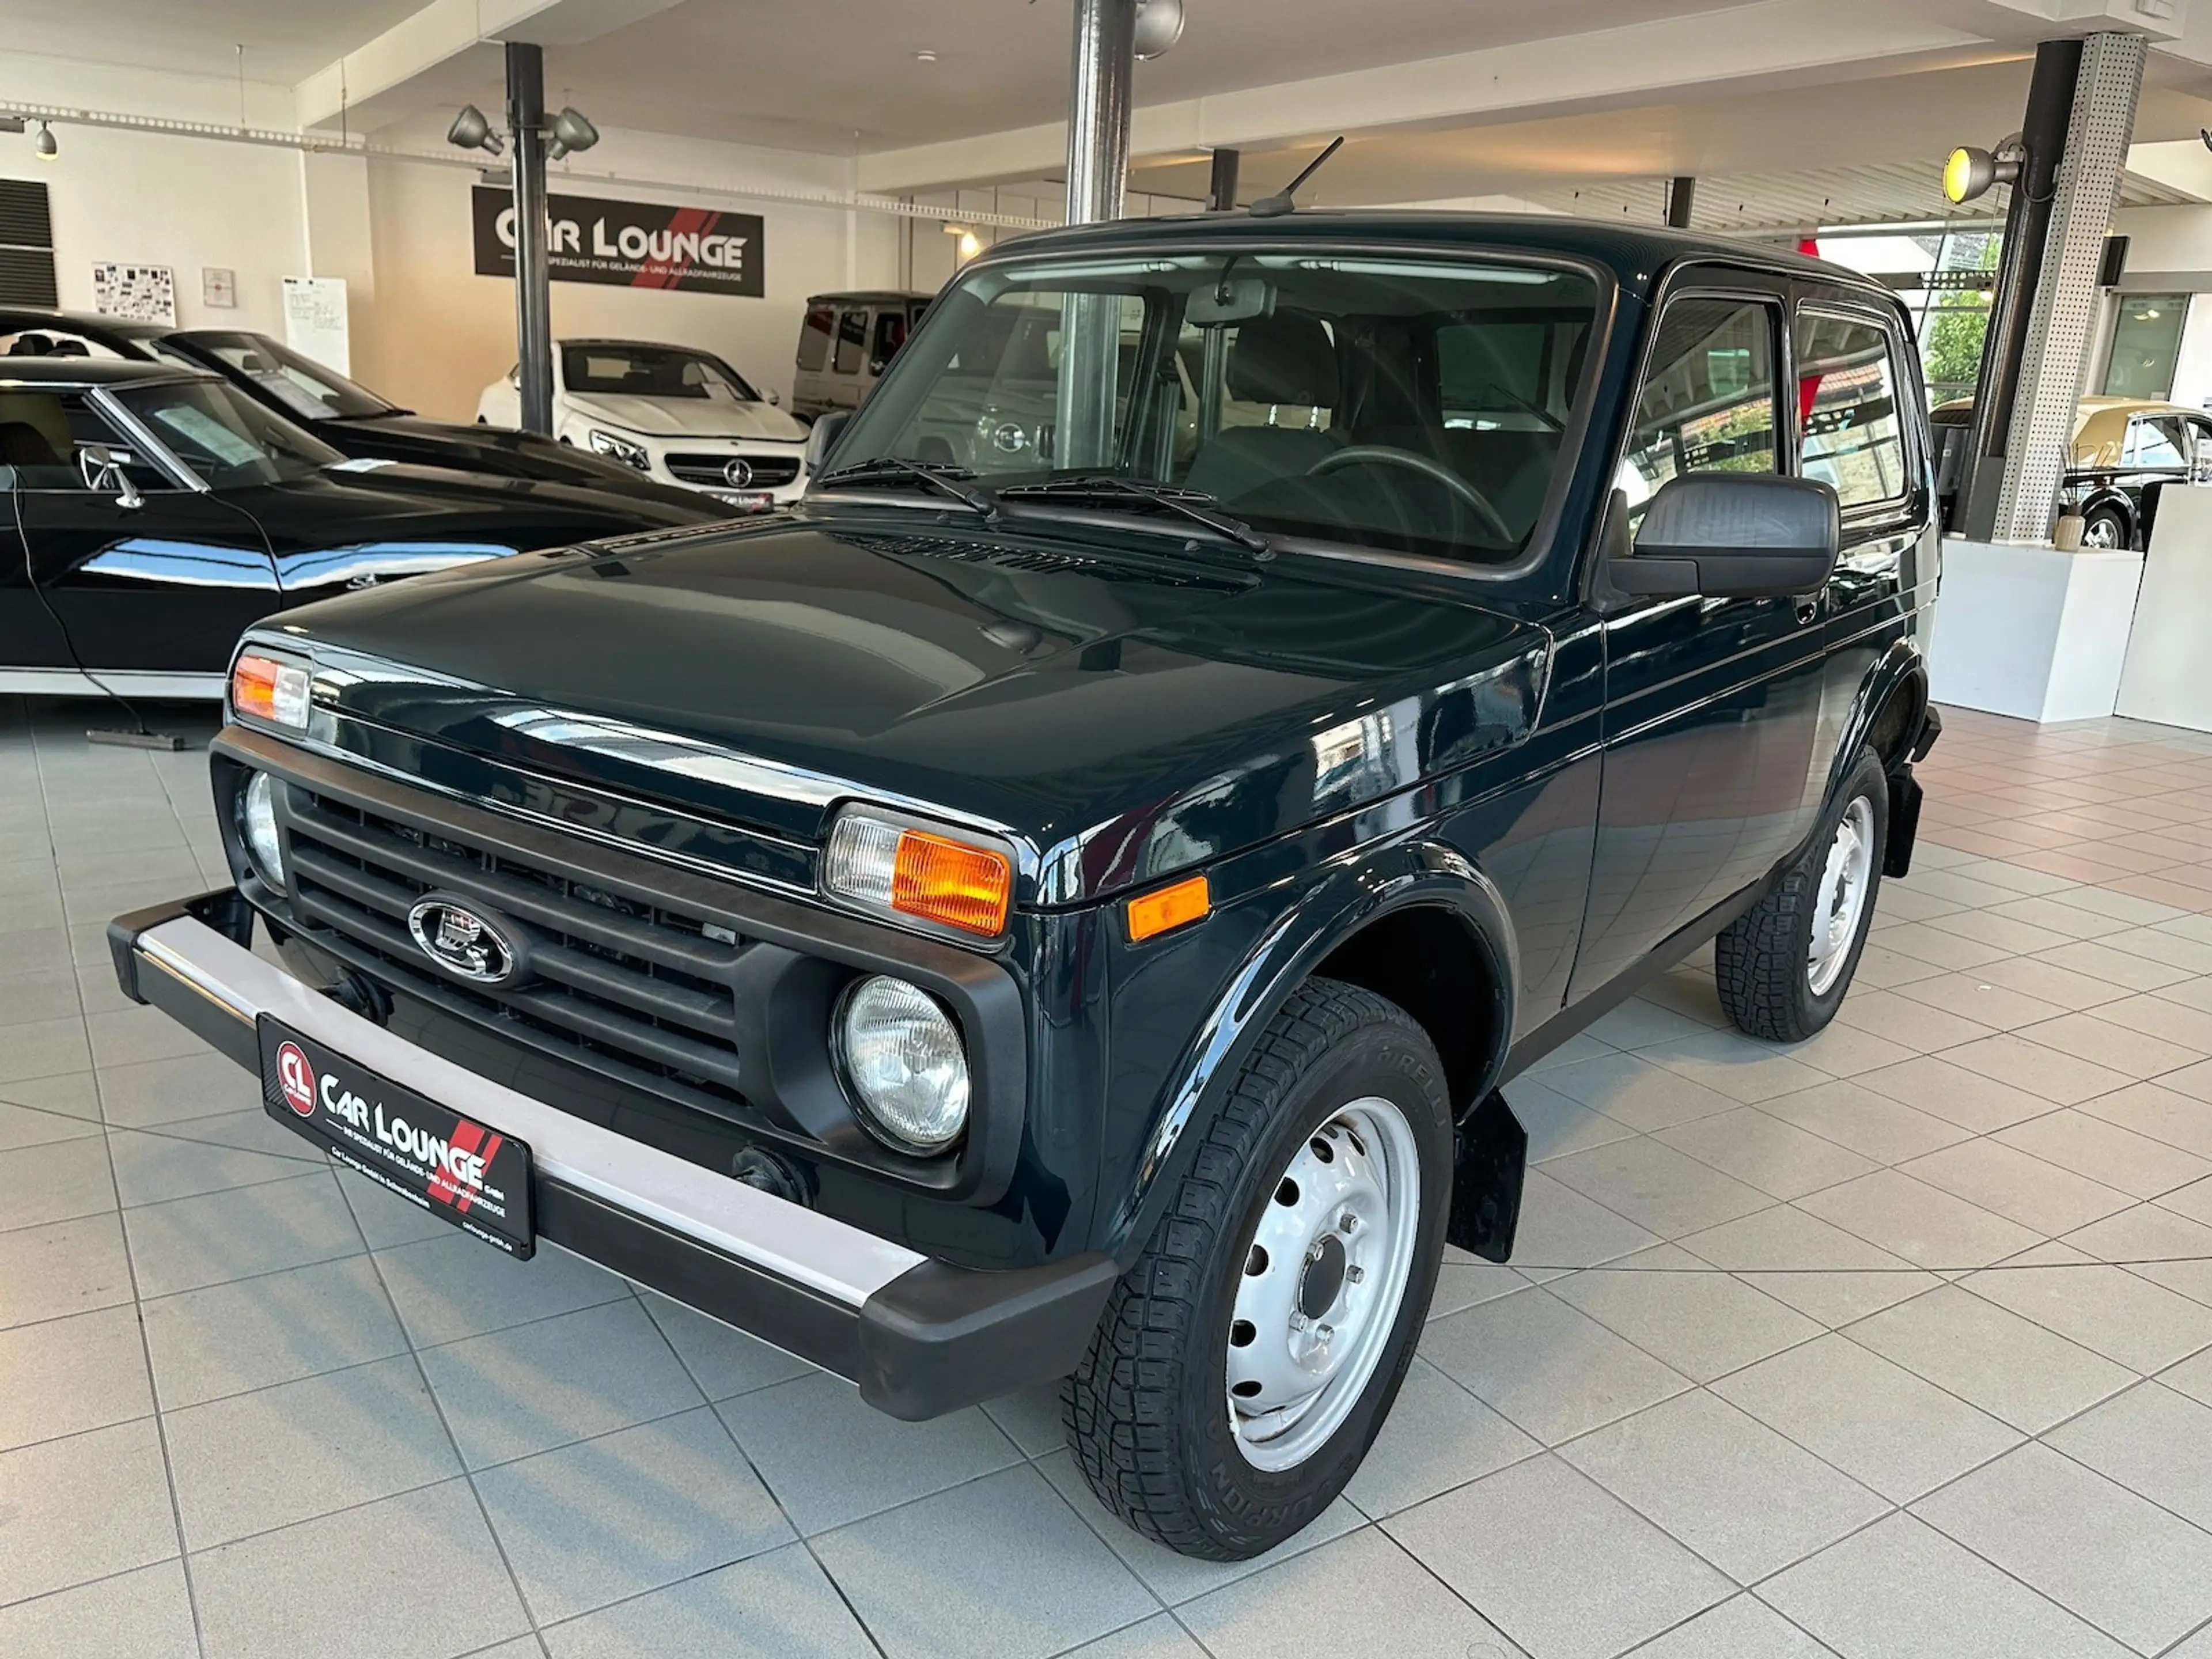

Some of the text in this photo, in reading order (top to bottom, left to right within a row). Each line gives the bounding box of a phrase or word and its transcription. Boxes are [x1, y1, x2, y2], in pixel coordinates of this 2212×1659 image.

[592, 259, 607, 270] FÜR
[650, 264, 667, 275] UND
[593, 217, 748, 268] LOUNGE
[320, 1074, 370, 1132] CAR
[373, 1103, 486, 1190] LOUNGE
[342, 1152, 362, 1171] Lounge
[353, 1131, 382, 1155] SPEZIALIST
[382, 1148, 395, 1162] FÜR
[426, 1171, 441, 1185] UND
